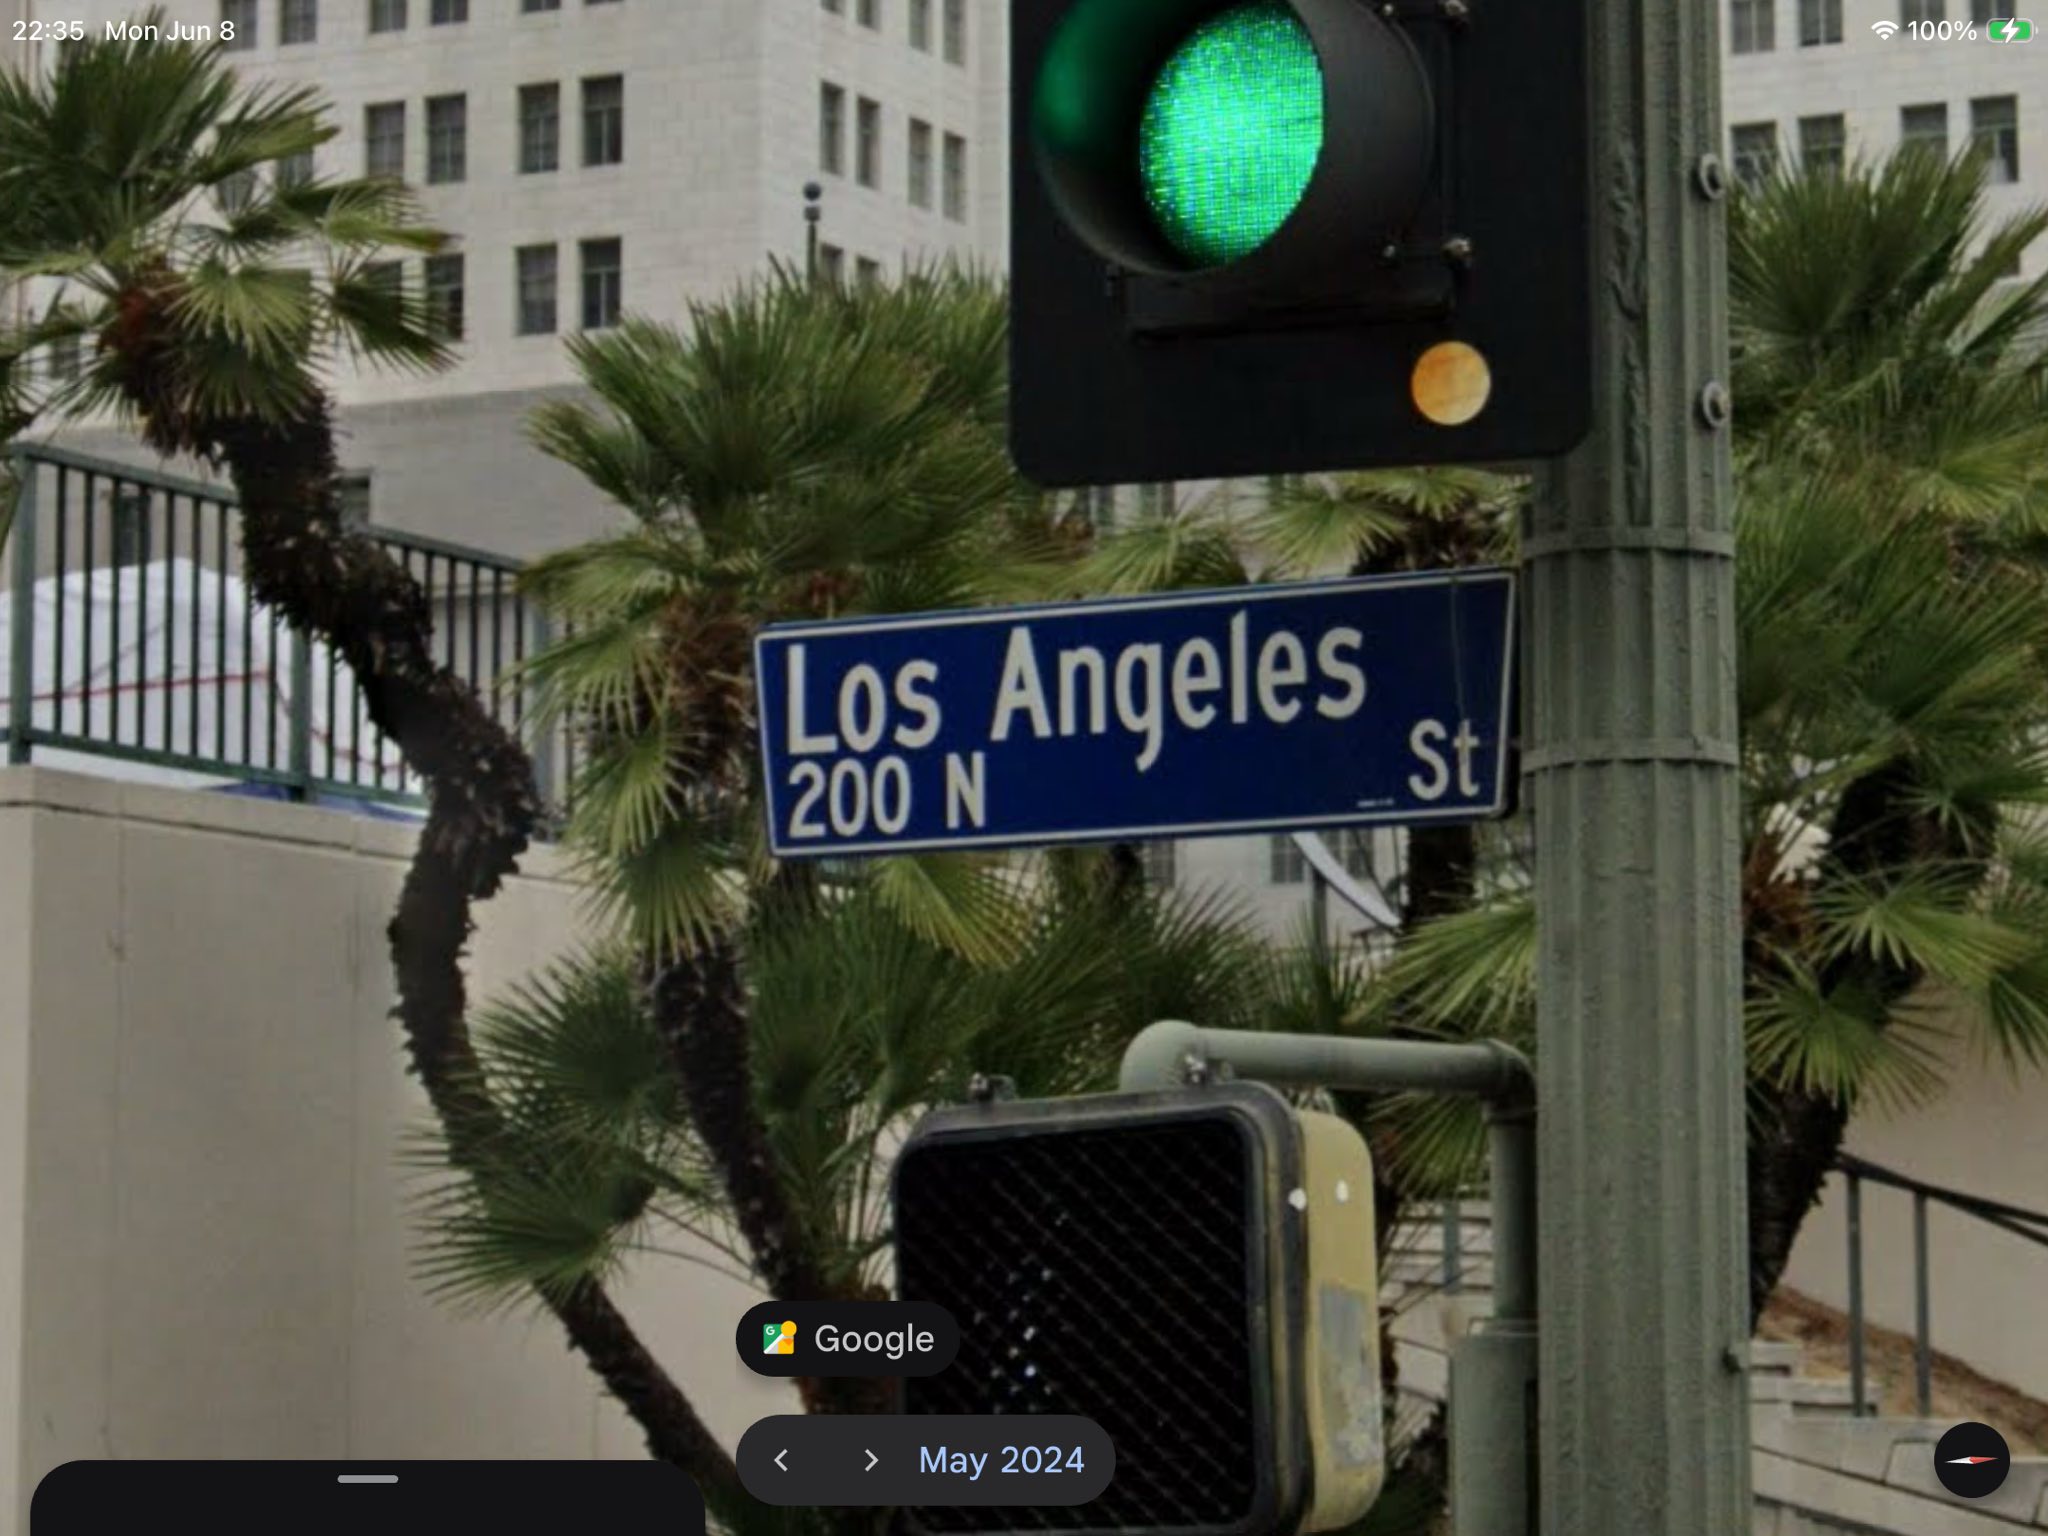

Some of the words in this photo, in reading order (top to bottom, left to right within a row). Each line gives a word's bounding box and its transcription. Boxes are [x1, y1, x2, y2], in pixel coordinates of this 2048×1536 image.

[787, 643, 941, 755] Los
[990, 609, 1367, 772] Angeles
[788, 755, 911, 838] 200
[945, 752, 986, 828] N
[1408, 717, 1480, 800] St
